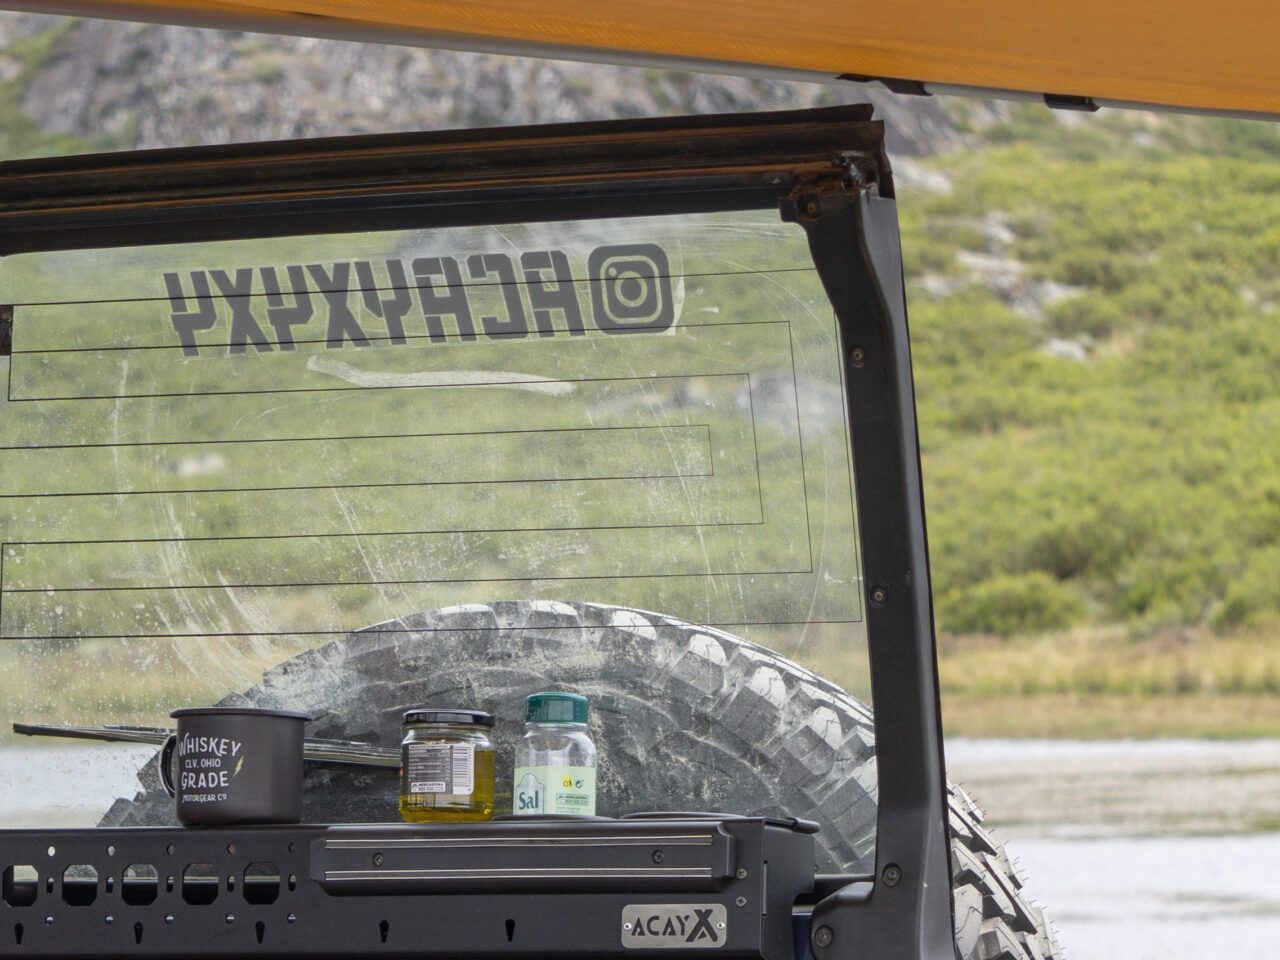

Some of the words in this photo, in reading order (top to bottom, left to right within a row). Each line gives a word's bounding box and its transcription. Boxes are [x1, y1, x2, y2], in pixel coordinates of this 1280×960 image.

[179, 732, 242, 757] WHISKEY
[201, 758, 221, 768] OHIO
[181, 770, 229, 790] GRADE
[519, 790, 539, 810] Sal
[631, 909, 718, 942] ACAYX
